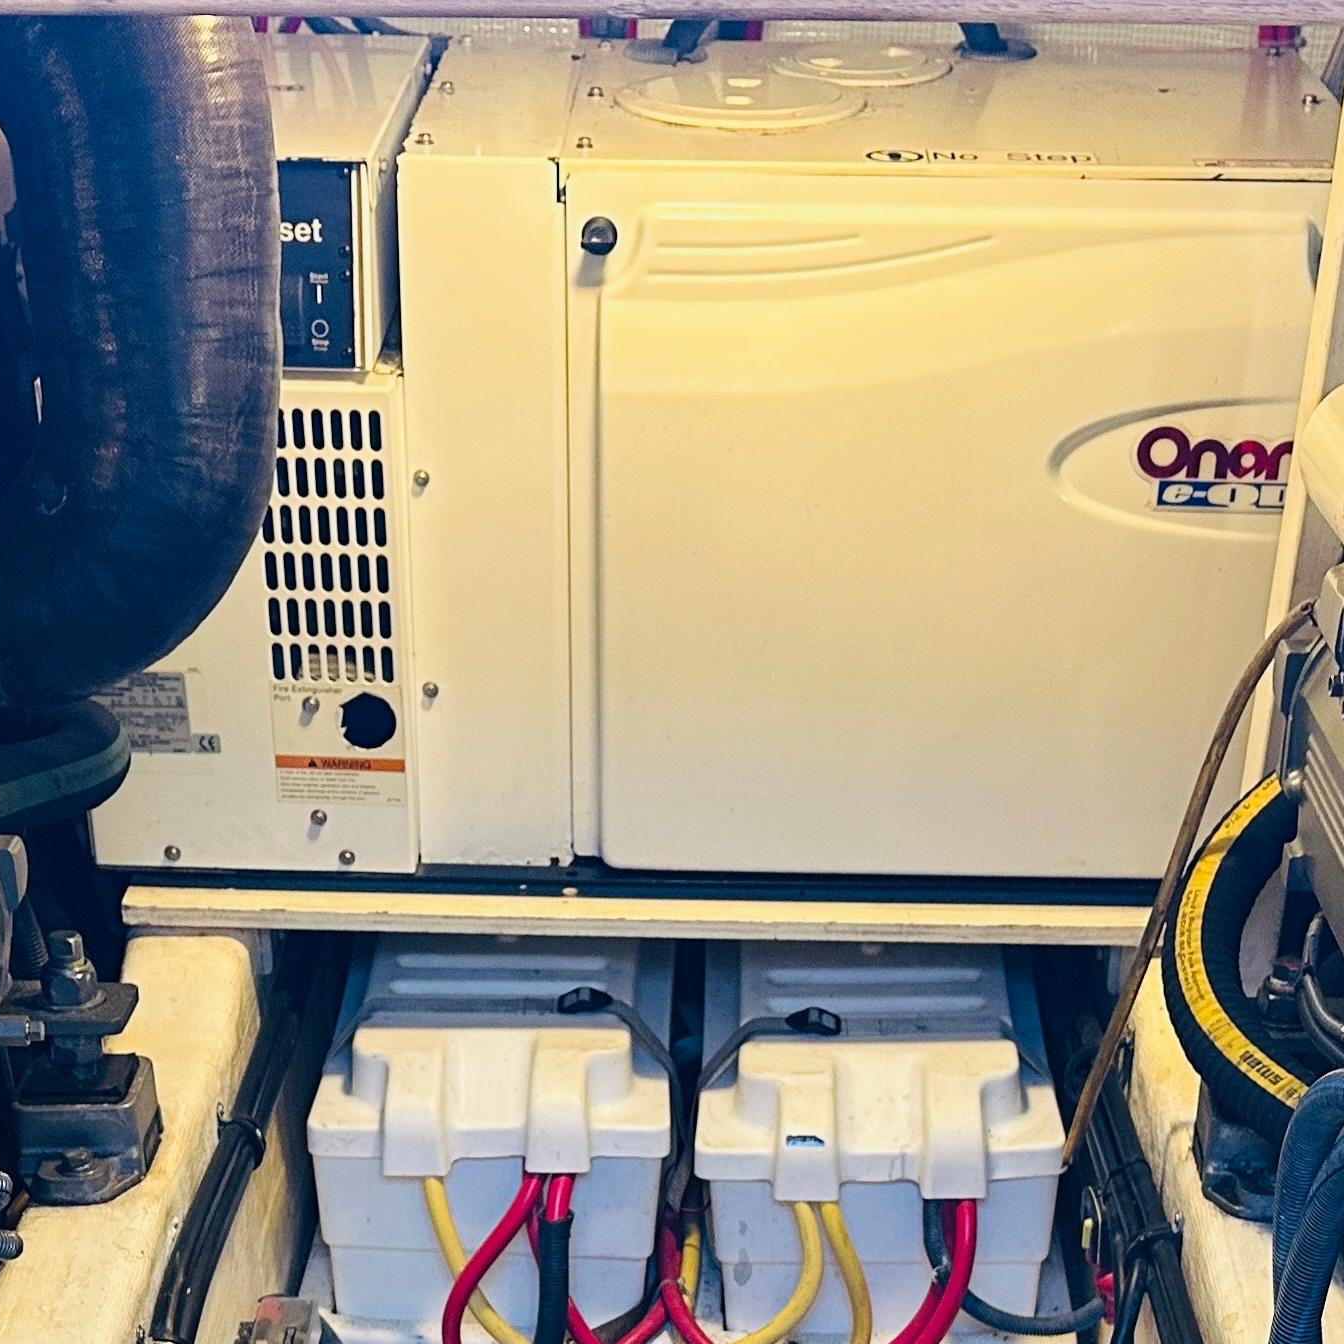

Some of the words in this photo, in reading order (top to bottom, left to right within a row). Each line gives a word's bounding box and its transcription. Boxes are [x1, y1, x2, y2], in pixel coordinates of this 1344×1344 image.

[932, 151, 978, 161] No
[1006, 151, 1092, 164] Step
[320, 758, 371, 770] WARNING
